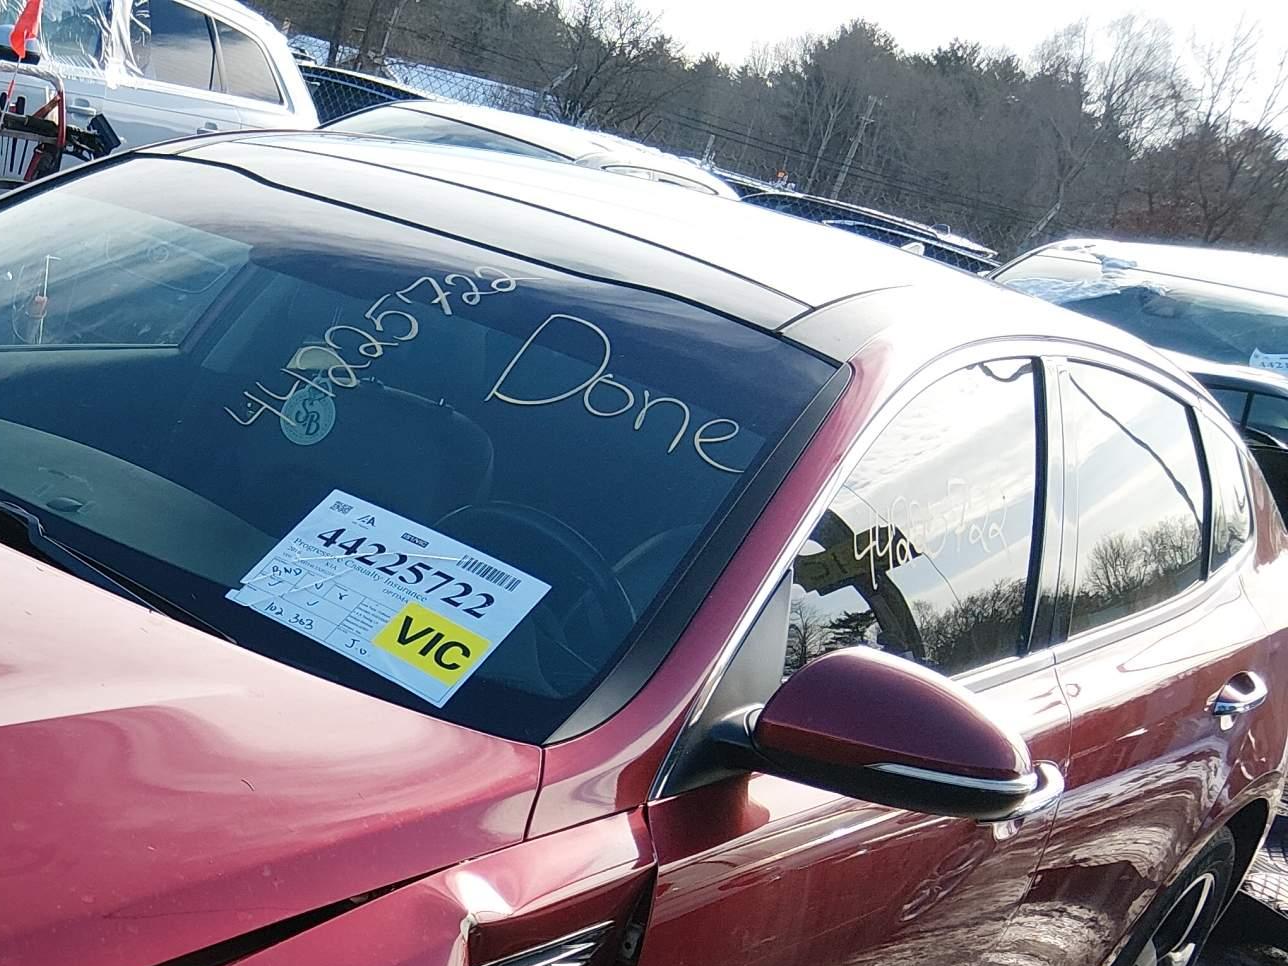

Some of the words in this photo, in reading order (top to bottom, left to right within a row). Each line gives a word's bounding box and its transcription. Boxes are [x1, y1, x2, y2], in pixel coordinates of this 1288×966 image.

[223, 265, 544, 427] 44225722
[484, 313, 746, 474] Done
[317, 528, 495, 619] 44225722
[383, 576, 428, 603] Insurance
[396, 615, 471, 671] VIC
